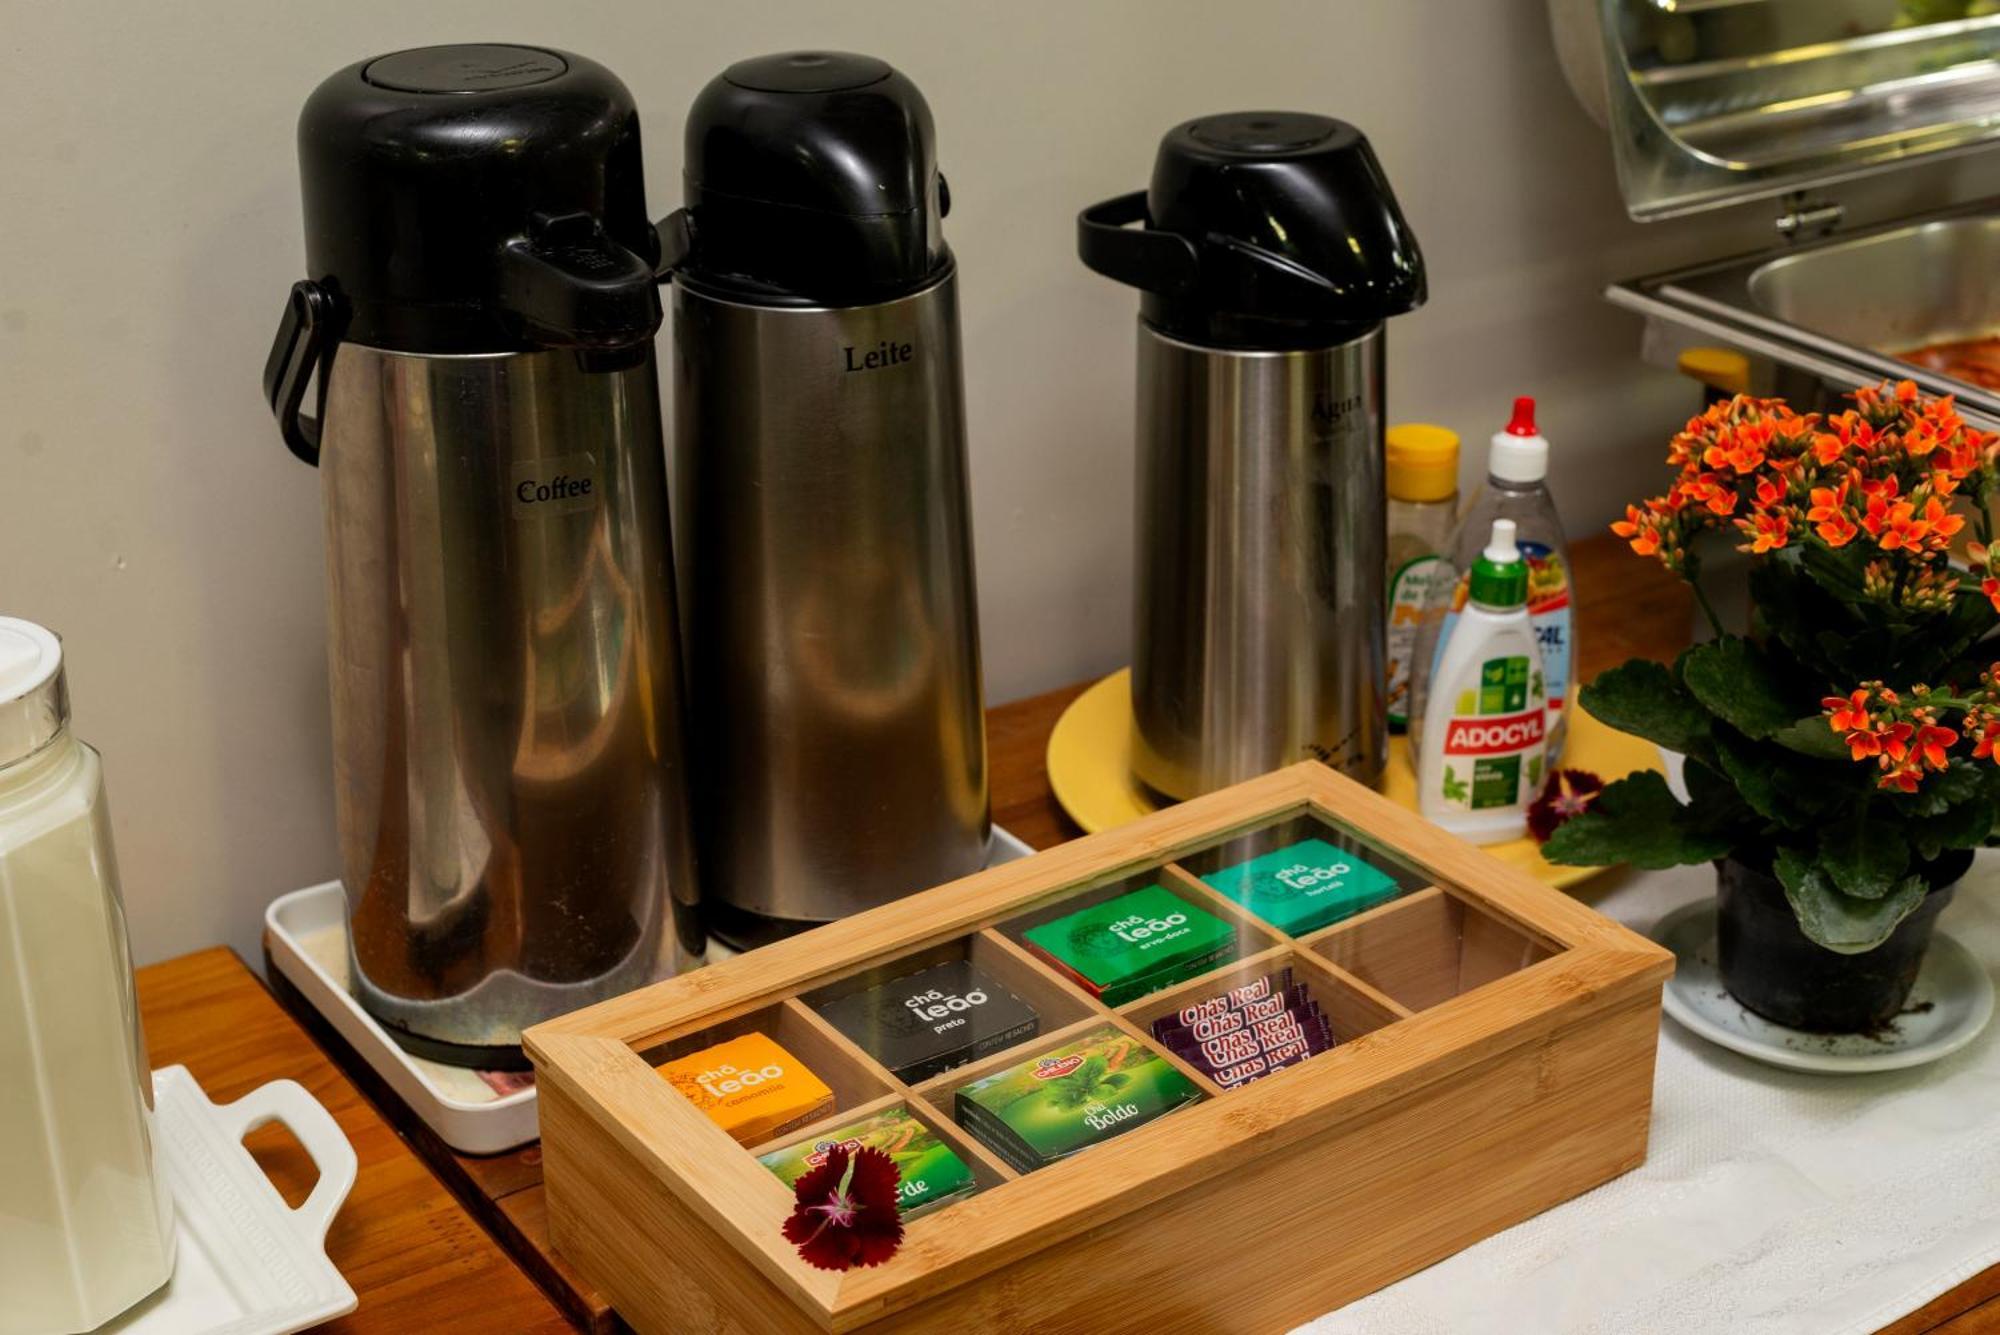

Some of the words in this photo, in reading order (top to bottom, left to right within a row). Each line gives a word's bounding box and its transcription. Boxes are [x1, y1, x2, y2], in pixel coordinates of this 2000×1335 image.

[843, 341, 912, 372] Leite
[516, 475, 592, 503] Coffee
[1534, 625, 1565, 646] AL
[1450, 718, 1542, 748] ADOCYL
[1282, 863, 1351, 889] leão
[1116, 913, 1188, 942] leão
[904, 988, 945, 1009] chá
[912, 989, 988, 1022] leão
[1228, 976, 1270, 1010] Real
[1243, 991, 1285, 1026] Real
[933, 1017, 967, 1035] preto
[1252, 1009, 1296, 1039] Real
[703, 1065, 784, 1098] leão
[1084, 1102, 1139, 1131] Boldo
